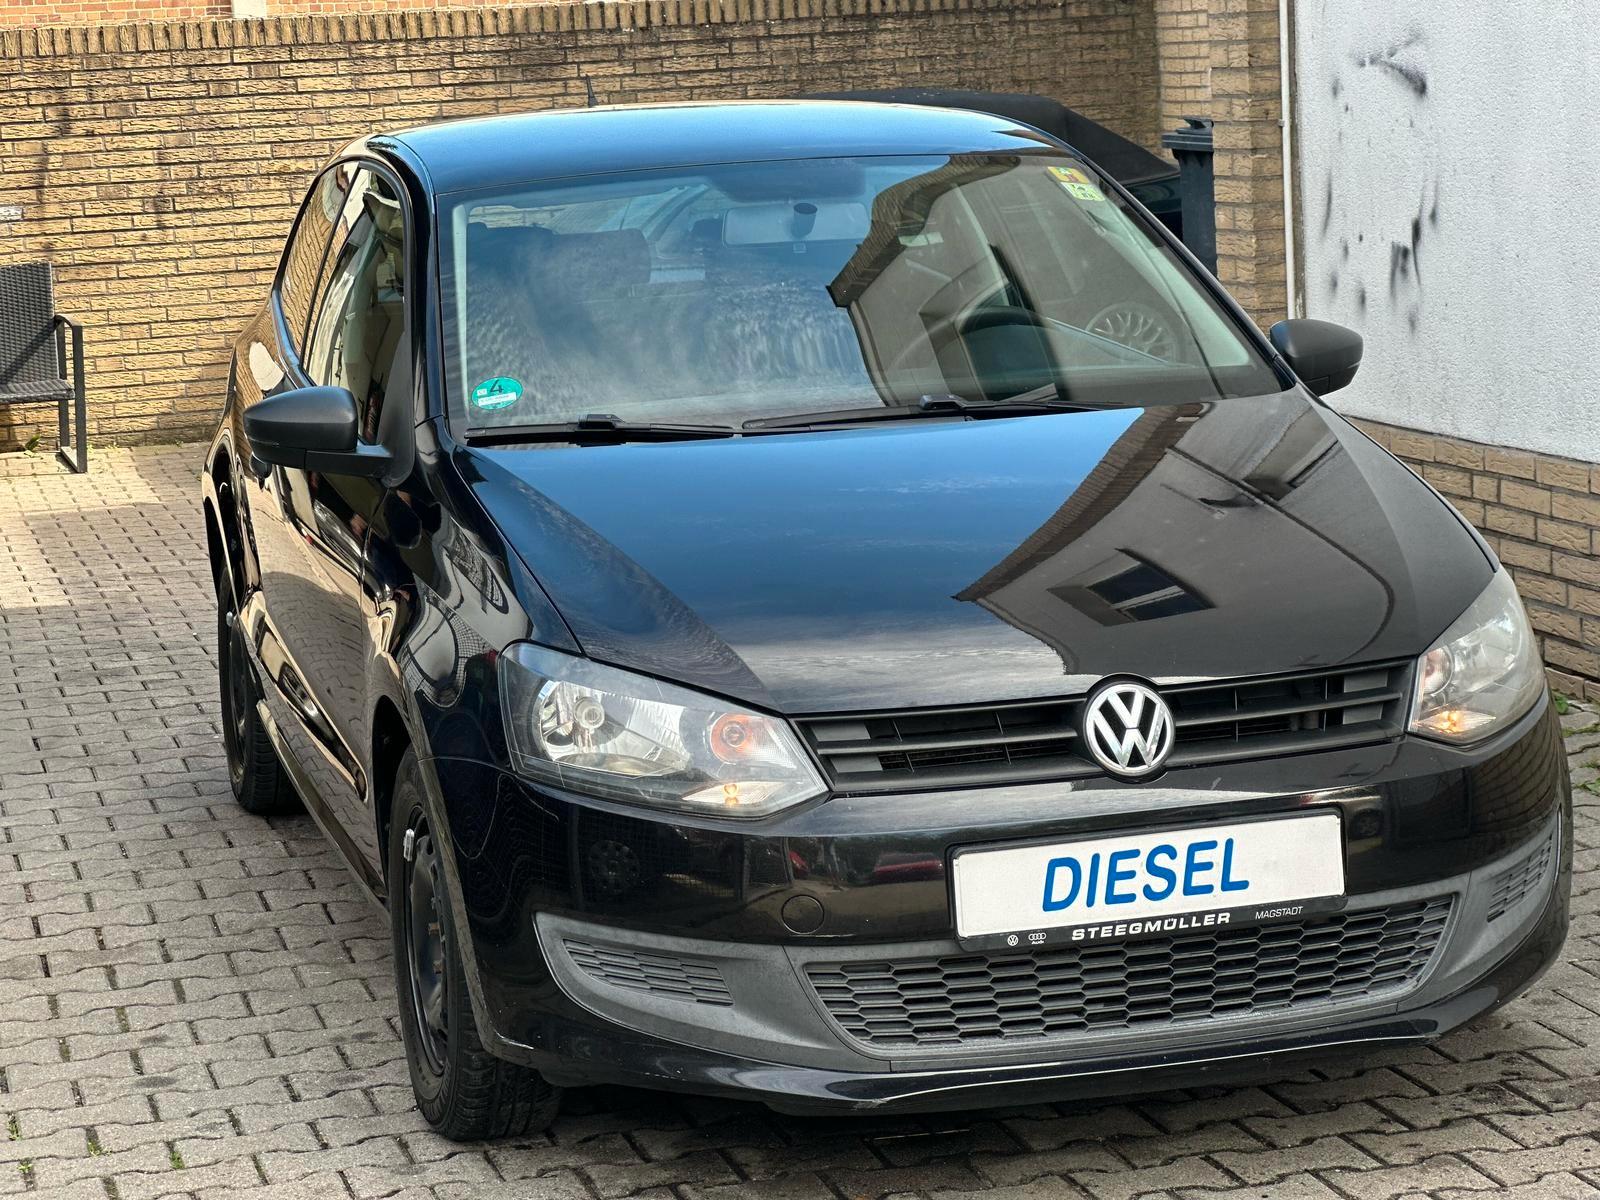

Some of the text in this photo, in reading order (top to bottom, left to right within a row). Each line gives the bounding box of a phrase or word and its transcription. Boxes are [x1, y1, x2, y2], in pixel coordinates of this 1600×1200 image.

[490, 379, 505, 394] 4
[1086, 684, 1171, 774] VW
[1042, 837, 1250, 913] DIESEL
[1072, 912, 1231, 941] STEEGMÜLLER
[1255, 905, 1304, 920] MAGSTADT
